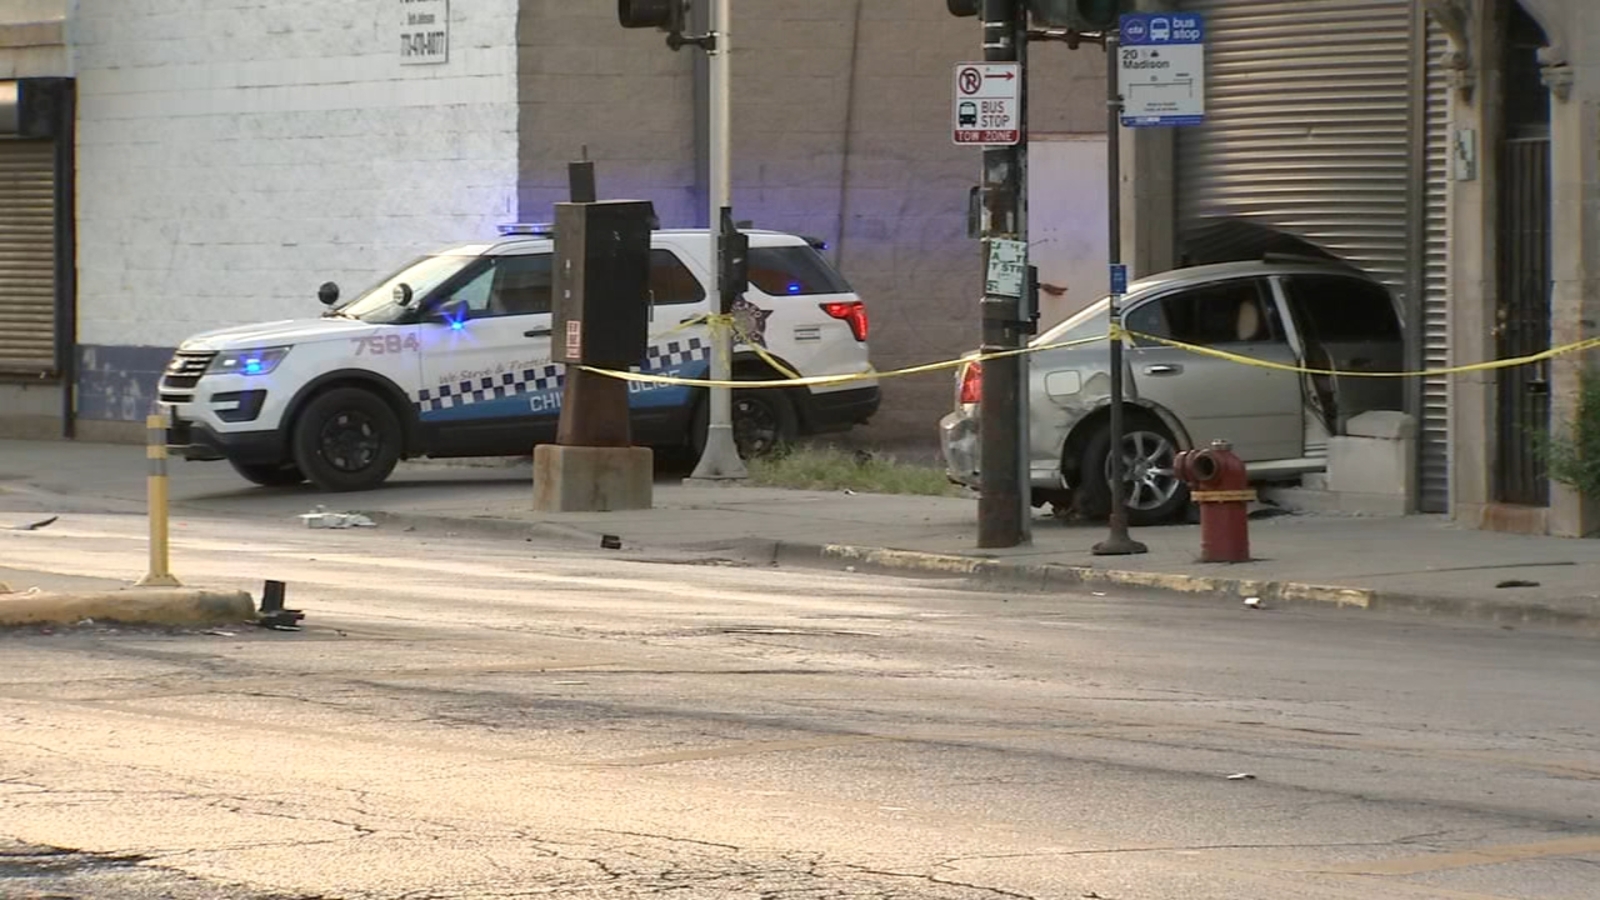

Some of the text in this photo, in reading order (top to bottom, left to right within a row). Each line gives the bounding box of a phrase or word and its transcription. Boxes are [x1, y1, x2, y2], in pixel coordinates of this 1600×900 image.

[1172, 17, 1195, 28] bus
[1172, 29, 1200, 40] stop
[1122, 49, 1138, 60] 20
[1122, 60, 1170, 70] Madison
[981, 101, 1005, 114] BUS
[981, 115, 1011, 128] STOP
[958, 131, 1014, 141] TOW ZONE
[349, 331, 420, 356] 7584
[529, 391, 564, 412] CHI
